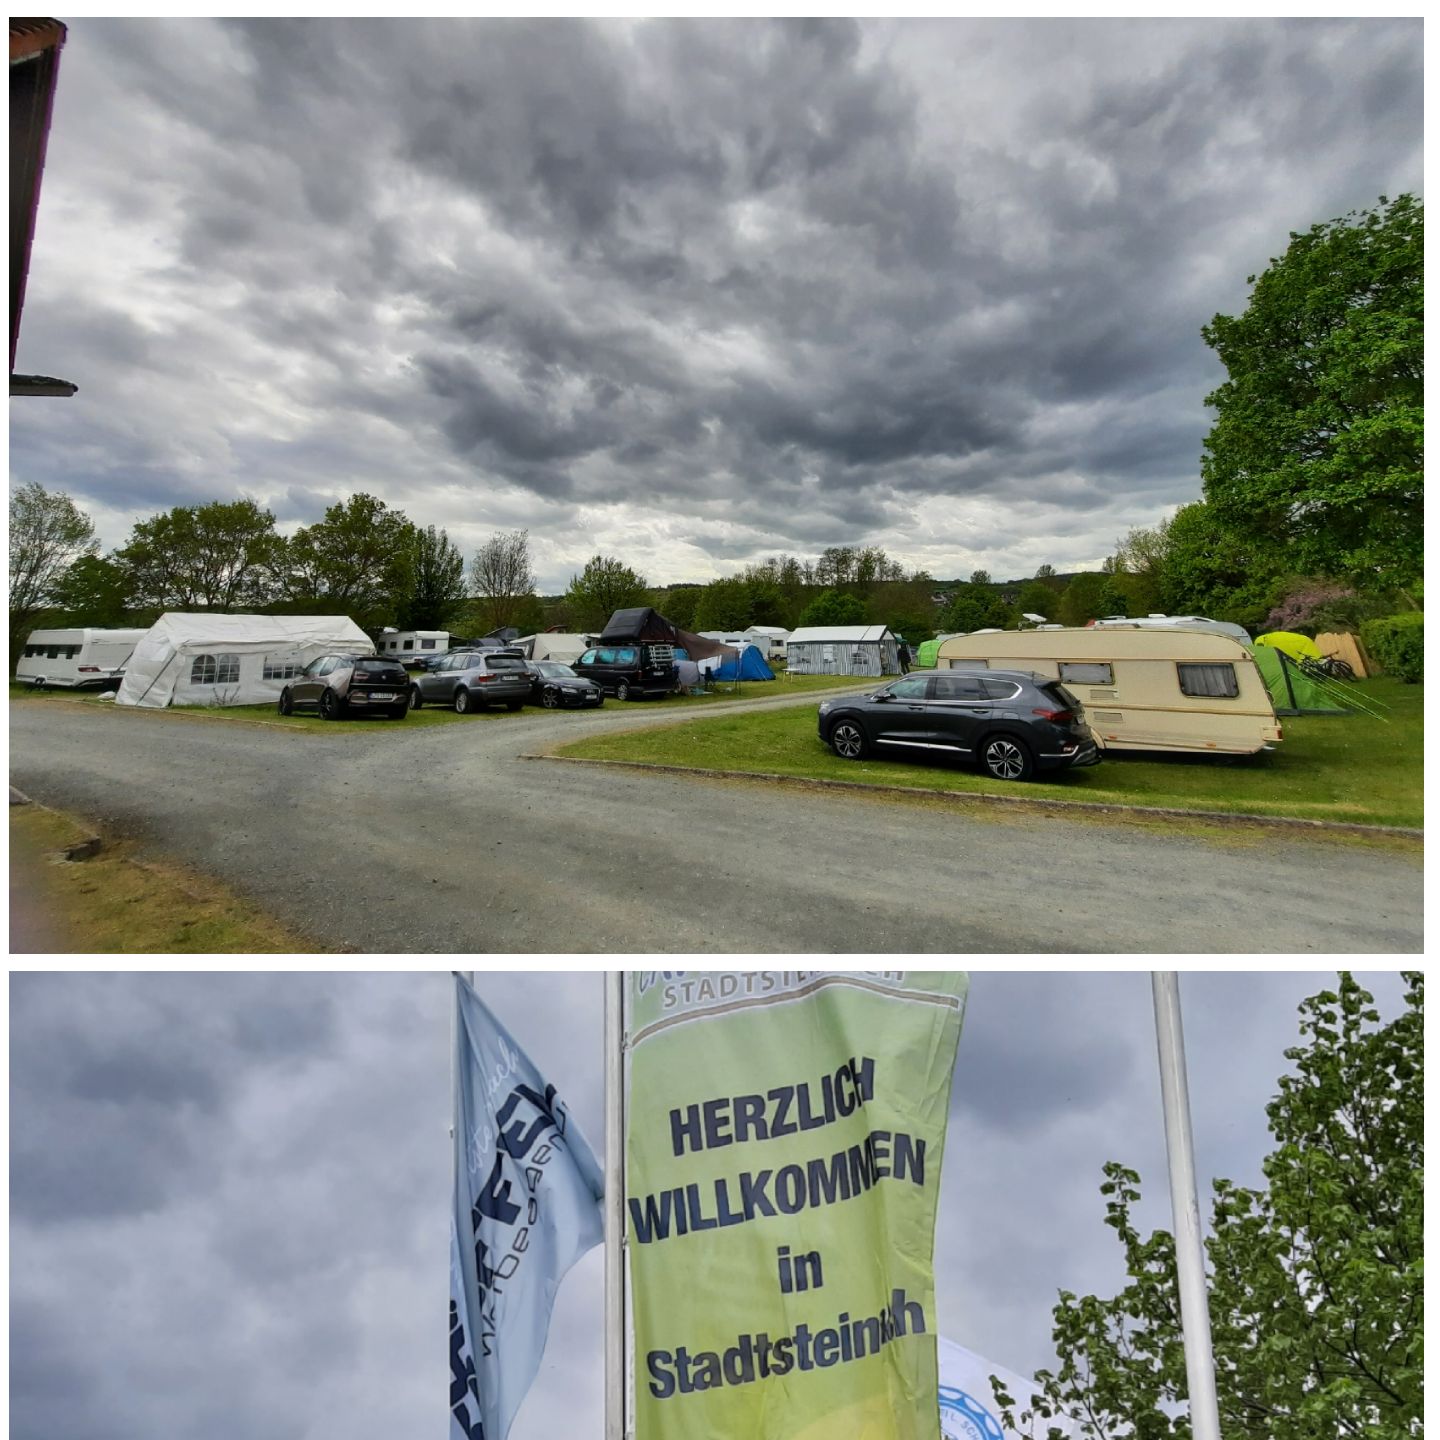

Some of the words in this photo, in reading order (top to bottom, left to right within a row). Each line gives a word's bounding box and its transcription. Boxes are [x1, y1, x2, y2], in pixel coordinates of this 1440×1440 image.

[670, 1056, 875, 1157] HERZLICH
[628, 1130, 926, 1244] WILLKOMMEN
[777, 1245, 823, 1294] in
